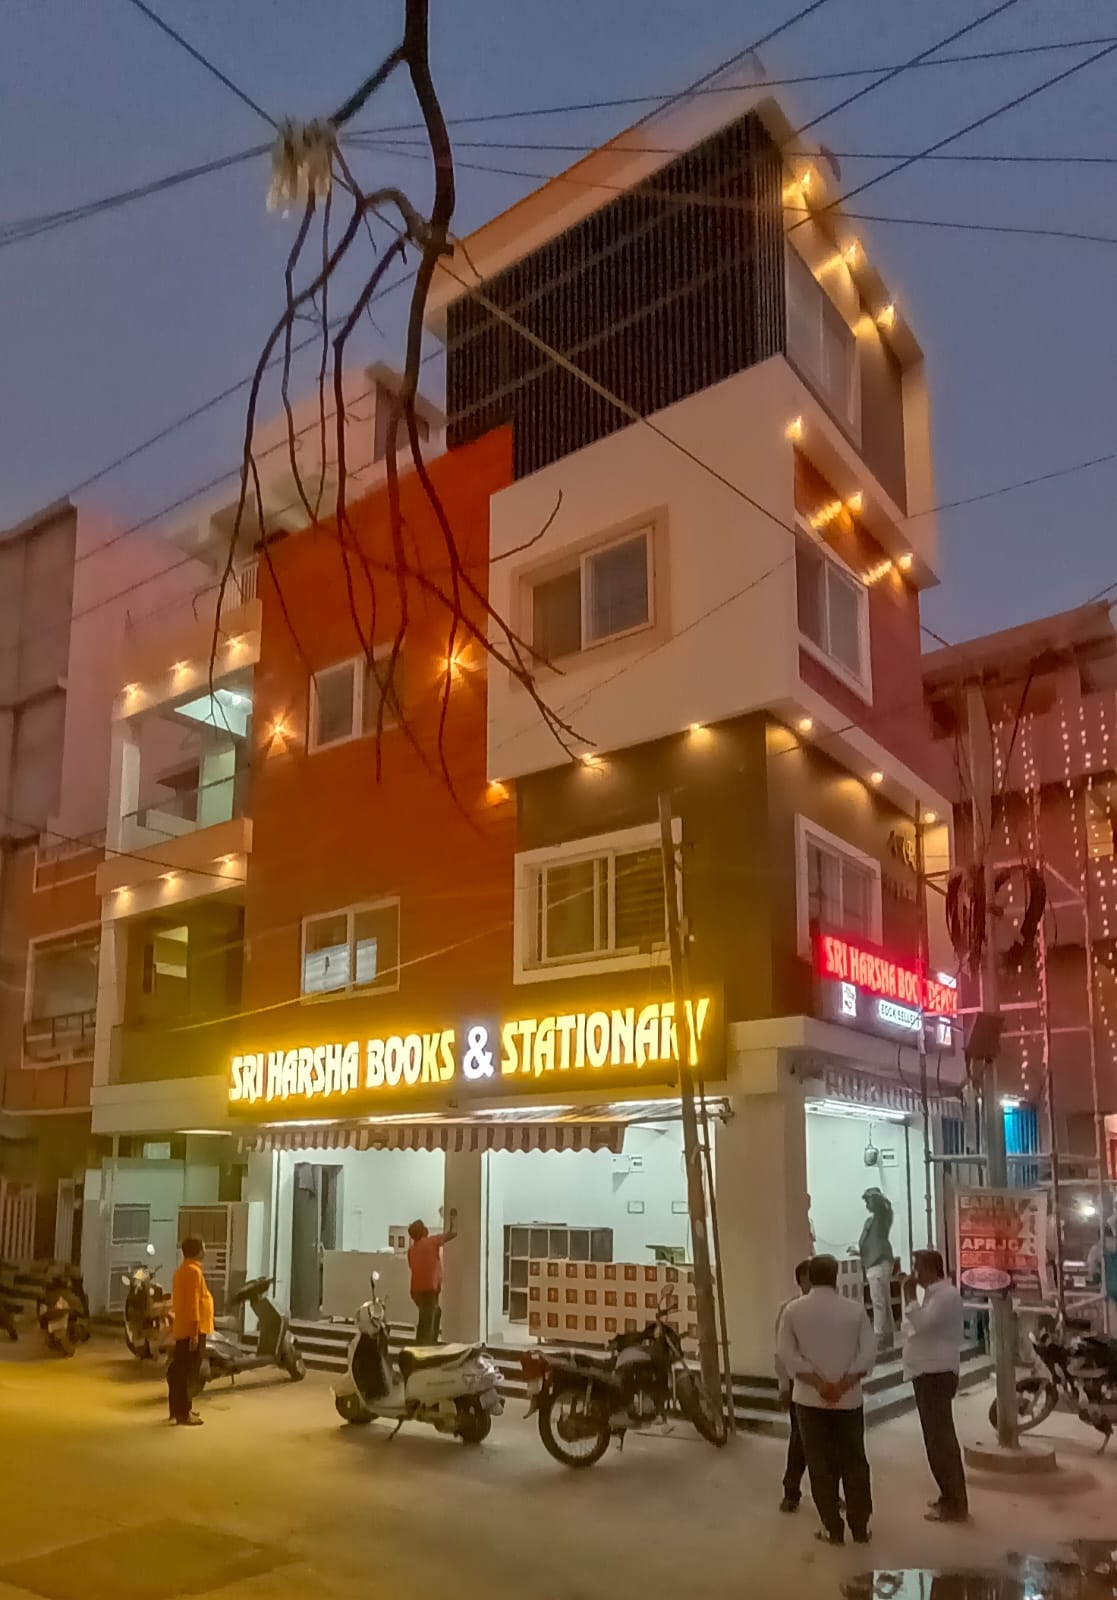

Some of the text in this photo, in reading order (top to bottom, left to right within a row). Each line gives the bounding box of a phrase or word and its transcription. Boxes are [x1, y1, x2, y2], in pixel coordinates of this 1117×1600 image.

[825, 936, 848, 979] SRI
[849, 946, 897, 996] HARSHA
[229, 1055, 264, 1104] SRI
[265, 1040, 359, 1103] HARSHA
[365, 1028, 456, 1089] BOOKS
[462, 1025, 495, 1080] &
